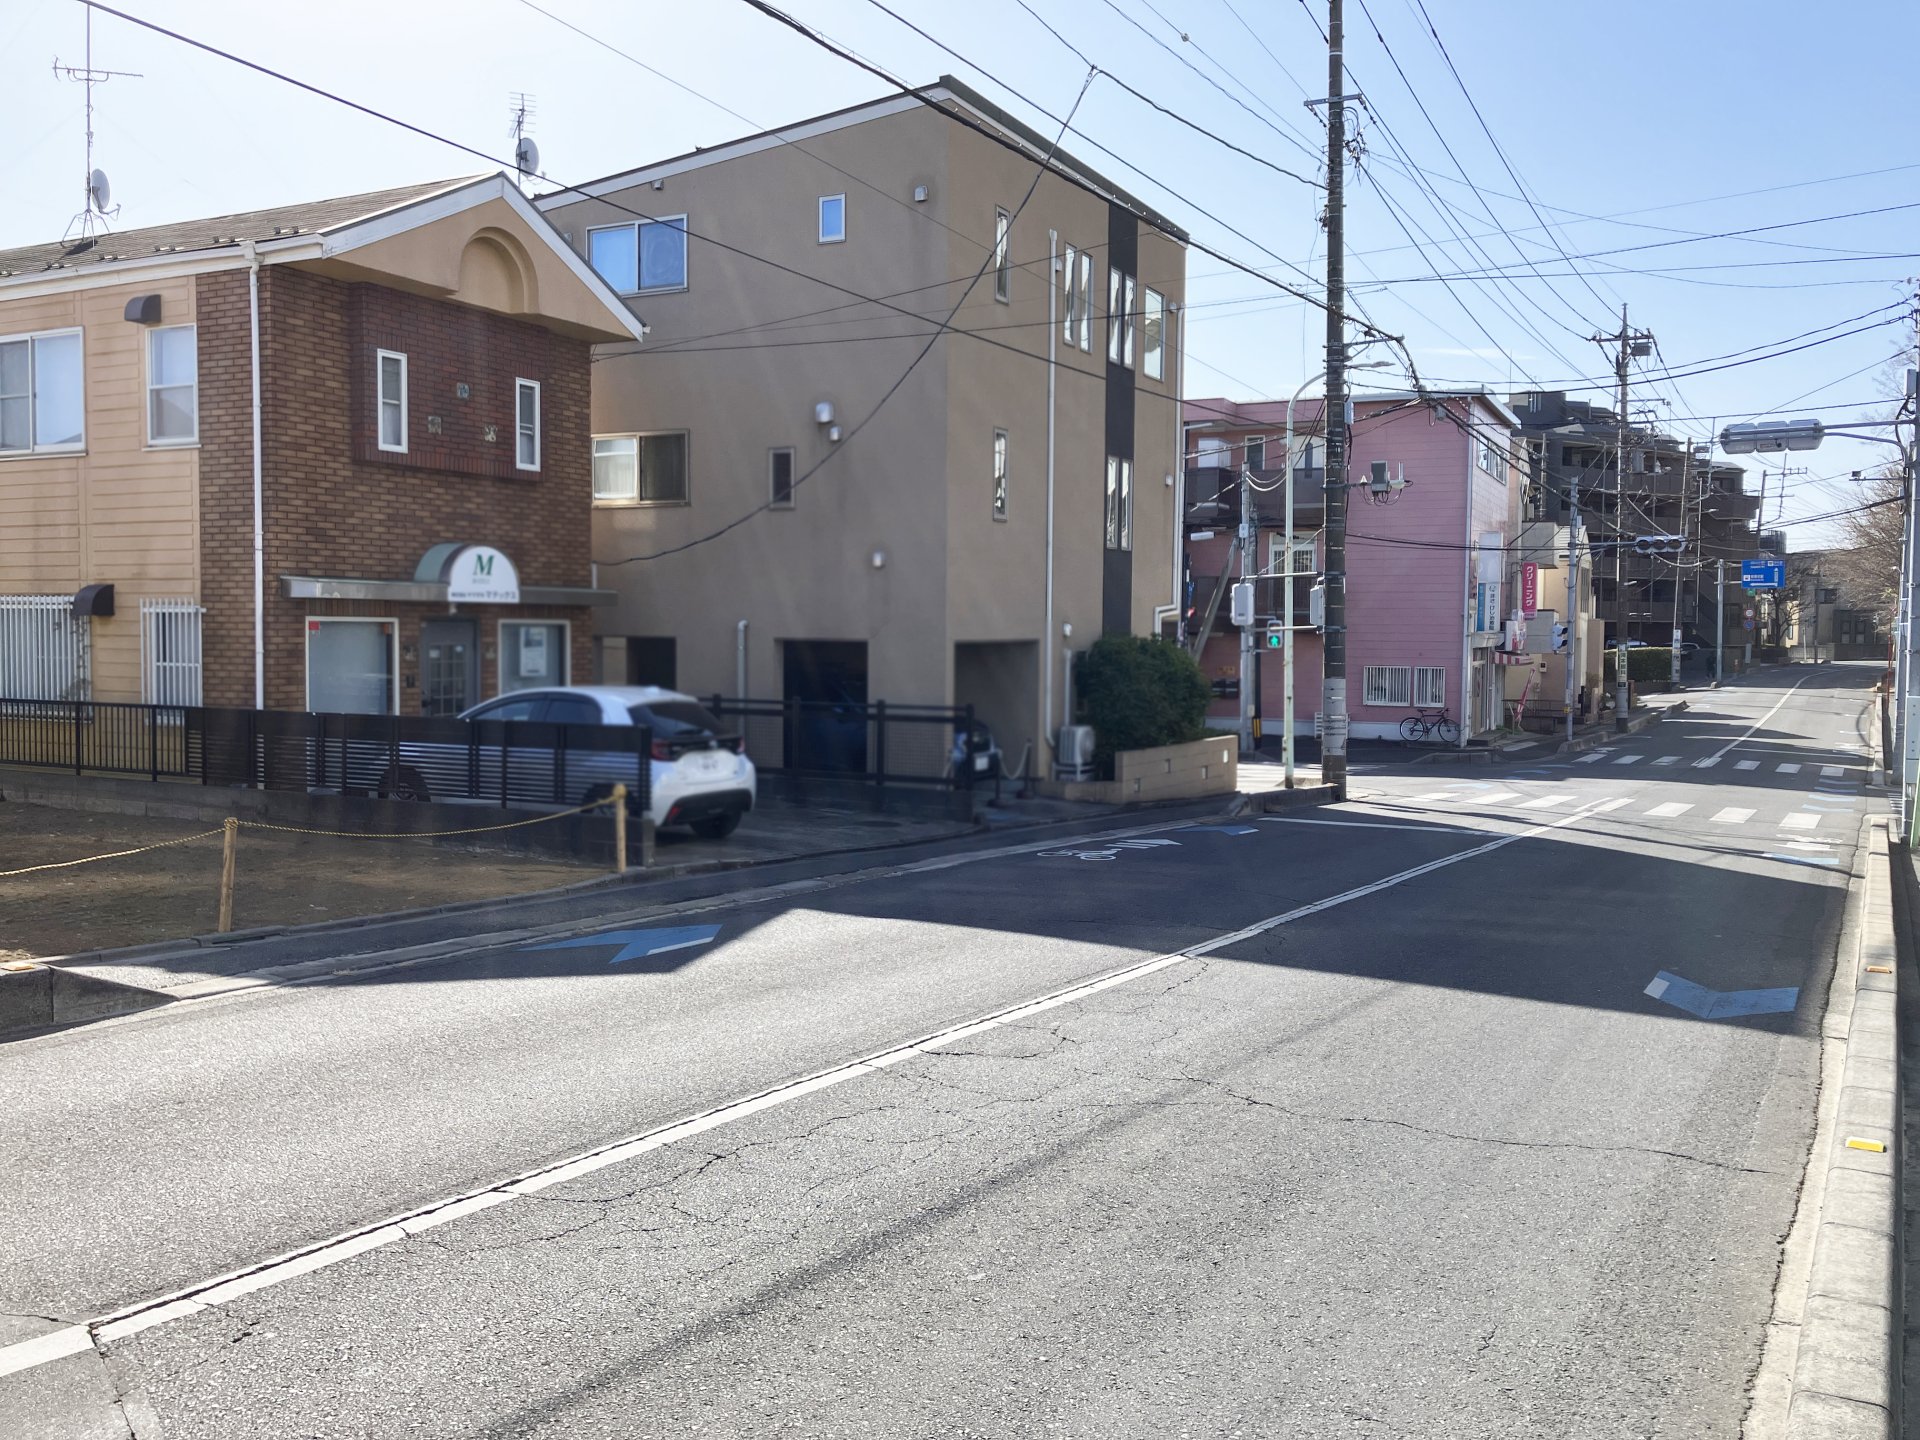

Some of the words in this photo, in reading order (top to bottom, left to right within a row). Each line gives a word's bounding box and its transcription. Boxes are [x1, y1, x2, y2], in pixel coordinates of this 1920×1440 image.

[473, 554, 494, 576] M
[1526, 566, 1534, 607] クリーニング
